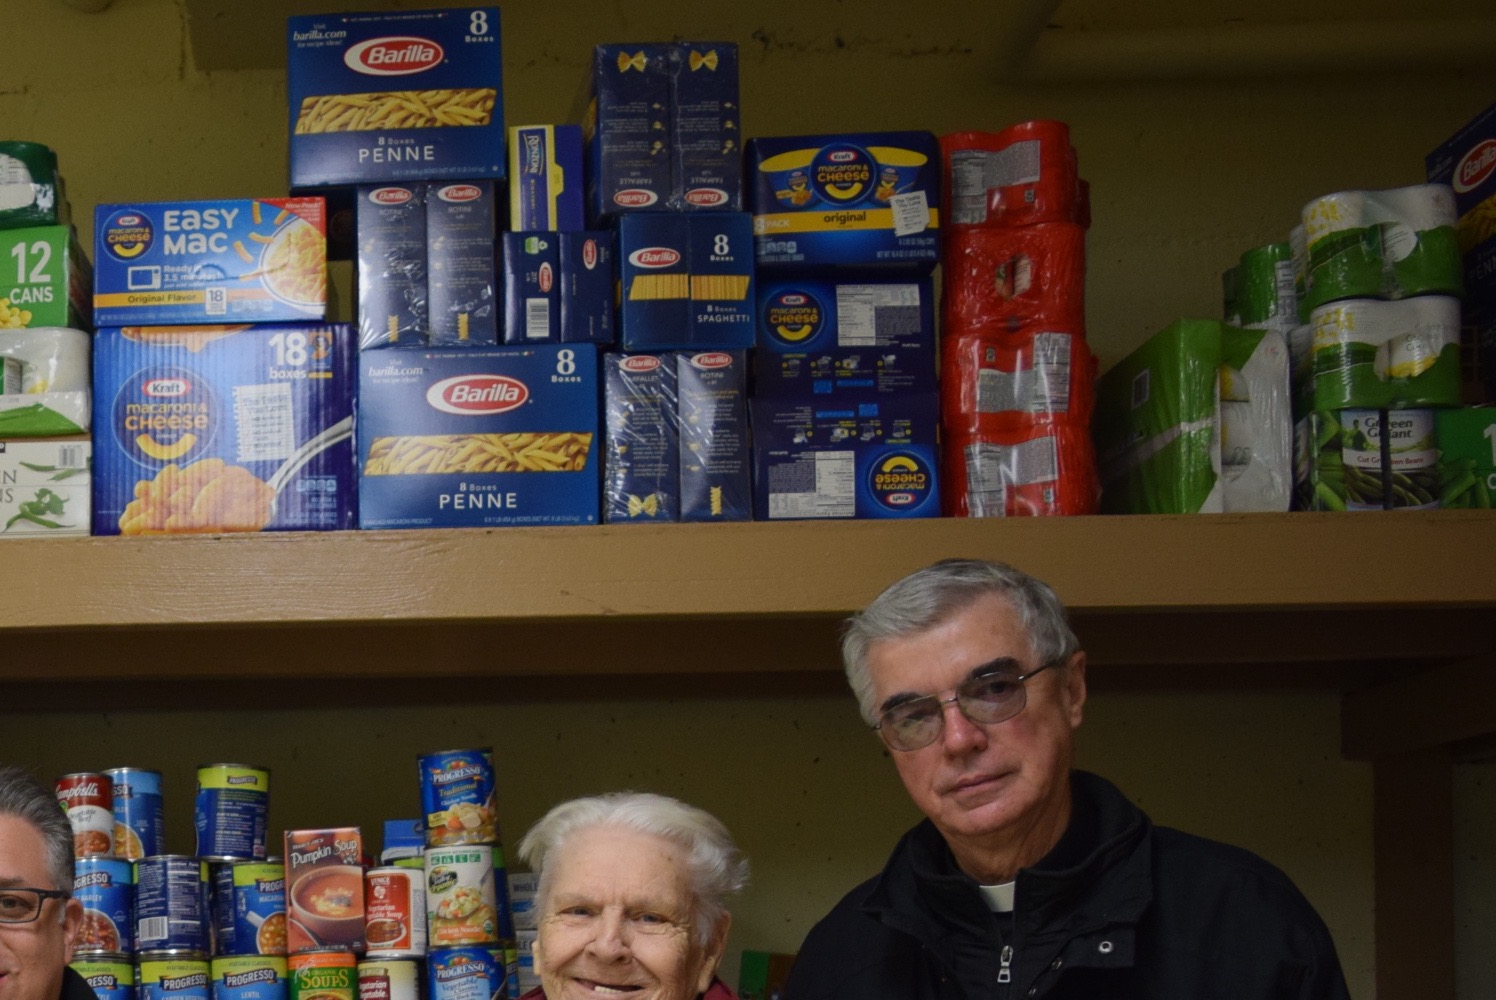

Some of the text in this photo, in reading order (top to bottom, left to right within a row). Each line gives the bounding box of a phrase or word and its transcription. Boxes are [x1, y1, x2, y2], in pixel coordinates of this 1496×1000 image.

[470, 11, 488, 34] 8
[293, 30, 346, 40] barilla.com
[367, 45, 435, 64] Barilla
[378, 137, 385, 145] 8
[358, 145, 435, 162] PENNE
[1463, 146, 1496, 181] Barilla
[379, 191, 408, 201] Barilla
[447, 188, 478, 198] Barilla
[767, 219, 790, 228] PACK
[824, 212, 866, 224] original
[714, 234, 729, 255] 8
[11, 241, 51, 284] 12
[641, 252, 675, 262] Barilla
[710, 254, 734, 262] Boxes
[164, 265, 192, 274] Ready
[10, 287, 53, 304] CANS
[127, 293, 196, 304] Original Flavor
[209, 291, 224, 301] 18
[697, 314, 750, 323] SPAGHETTI
[269, 333, 306, 366] 18
[557, 349, 575, 375] 8
[628, 357, 660, 368] Barilla
[700, 354, 730, 365] Barilla
[269, 368, 306, 379] boxes
[369, 366, 423, 377] barilla.com
[700, 372, 724, 380] ROTINI
[551, 375, 581, 383] Boxes
[151, 384, 180, 393] Kraft
[450, 384, 519, 402] Barilla
[126, 403, 197, 414] macaroni
[1365, 417, 1413, 429] Green
[460, 483, 467, 491] 8
[439, 493, 517, 509] PENNE
[432, 767, 481, 784] PROGRESSO
[56, 783, 98, 798] Campbell's
[438, 781, 477, 797] Traditional
[290, 839, 357, 868] Pumpkin Soup
[370, 876, 390, 886] VENICE
[387, 911, 403, 919] Soup
[437, 963, 485, 979] PROGRESSO
[163, 974, 206, 990] PROGRESSO
[226, 970, 274, 987] PROGRESSO
[301, 970, 349, 989] SOUPS
[441, 978, 478, 991] Vegetable
